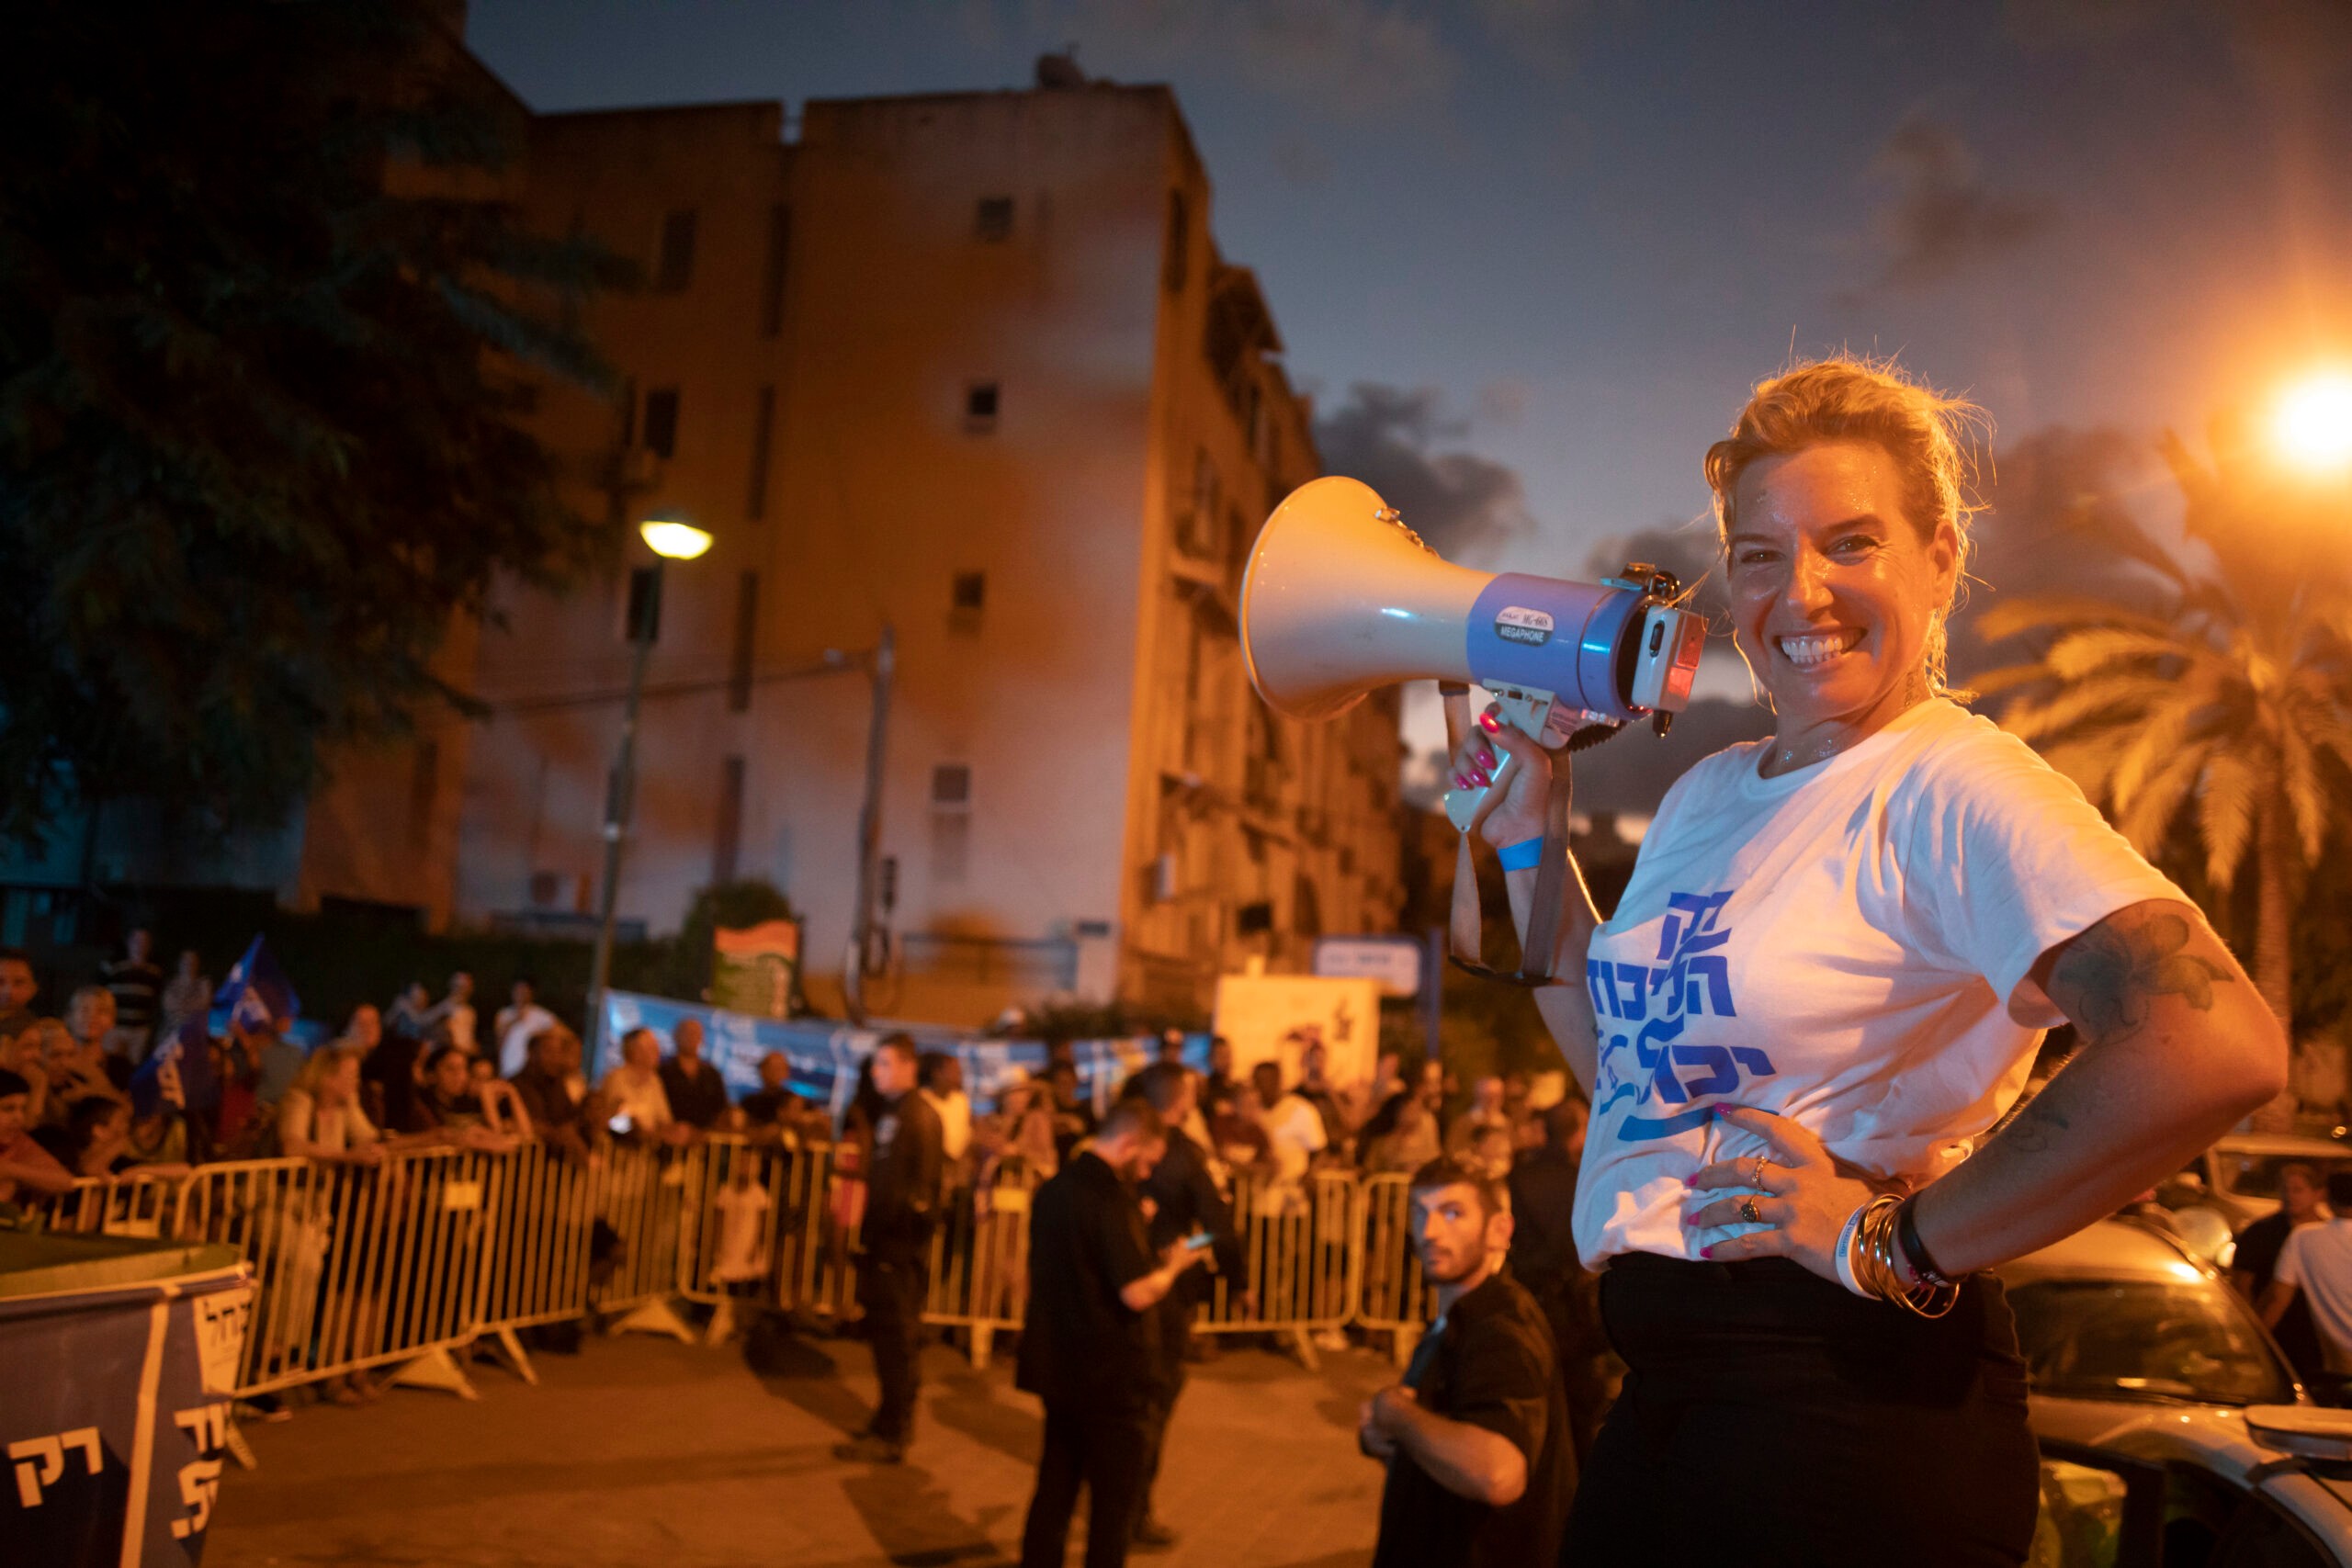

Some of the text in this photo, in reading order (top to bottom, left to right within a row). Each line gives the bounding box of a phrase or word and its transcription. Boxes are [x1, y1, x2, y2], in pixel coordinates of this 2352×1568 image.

[1500, 625, 1544, 643] MEGAPHONE
[1657, 890, 1734, 960] רק
[8, 1427, 103, 1508] רק
